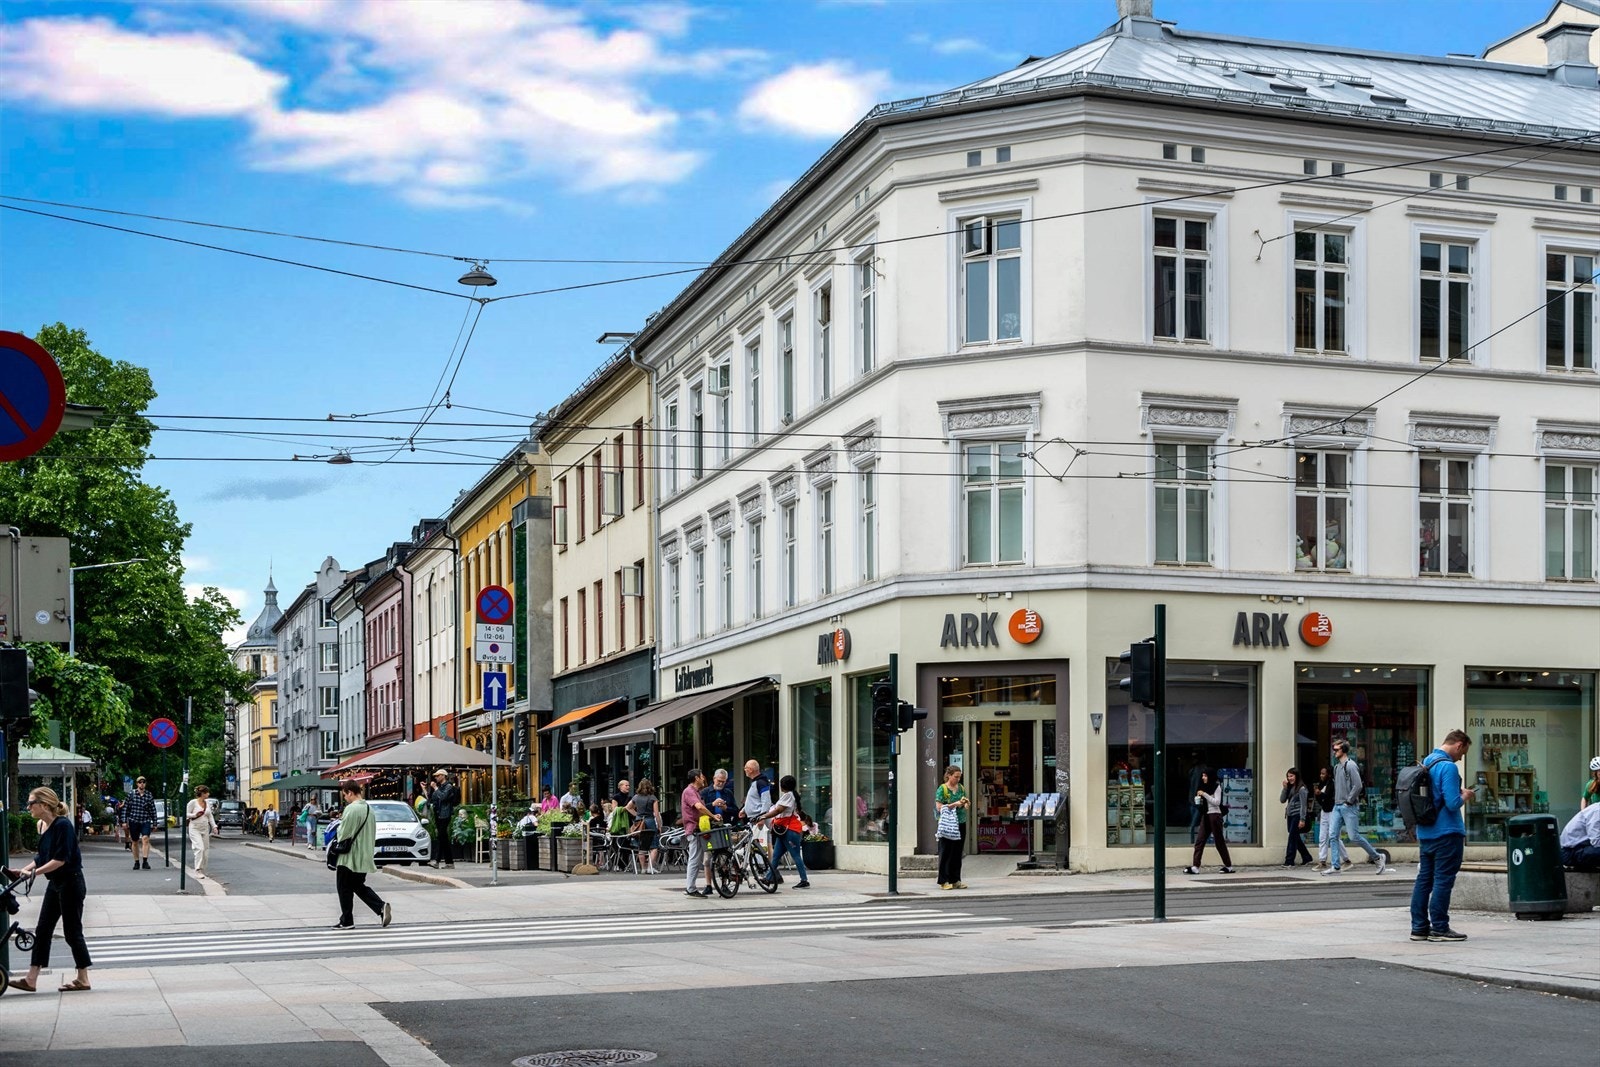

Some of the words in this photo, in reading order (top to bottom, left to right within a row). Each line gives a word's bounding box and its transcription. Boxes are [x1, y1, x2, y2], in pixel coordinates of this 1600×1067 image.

[940, 612, 999, 648] ARK
[1233, 612, 1290, 647] ARK
[1469, 718, 1485, 727] ARK
[1490, 718, 1536, 728] ANBEFALER
[980, 827, 997, 835] FINNE
[999, 825, 1007, 835] PÅ
